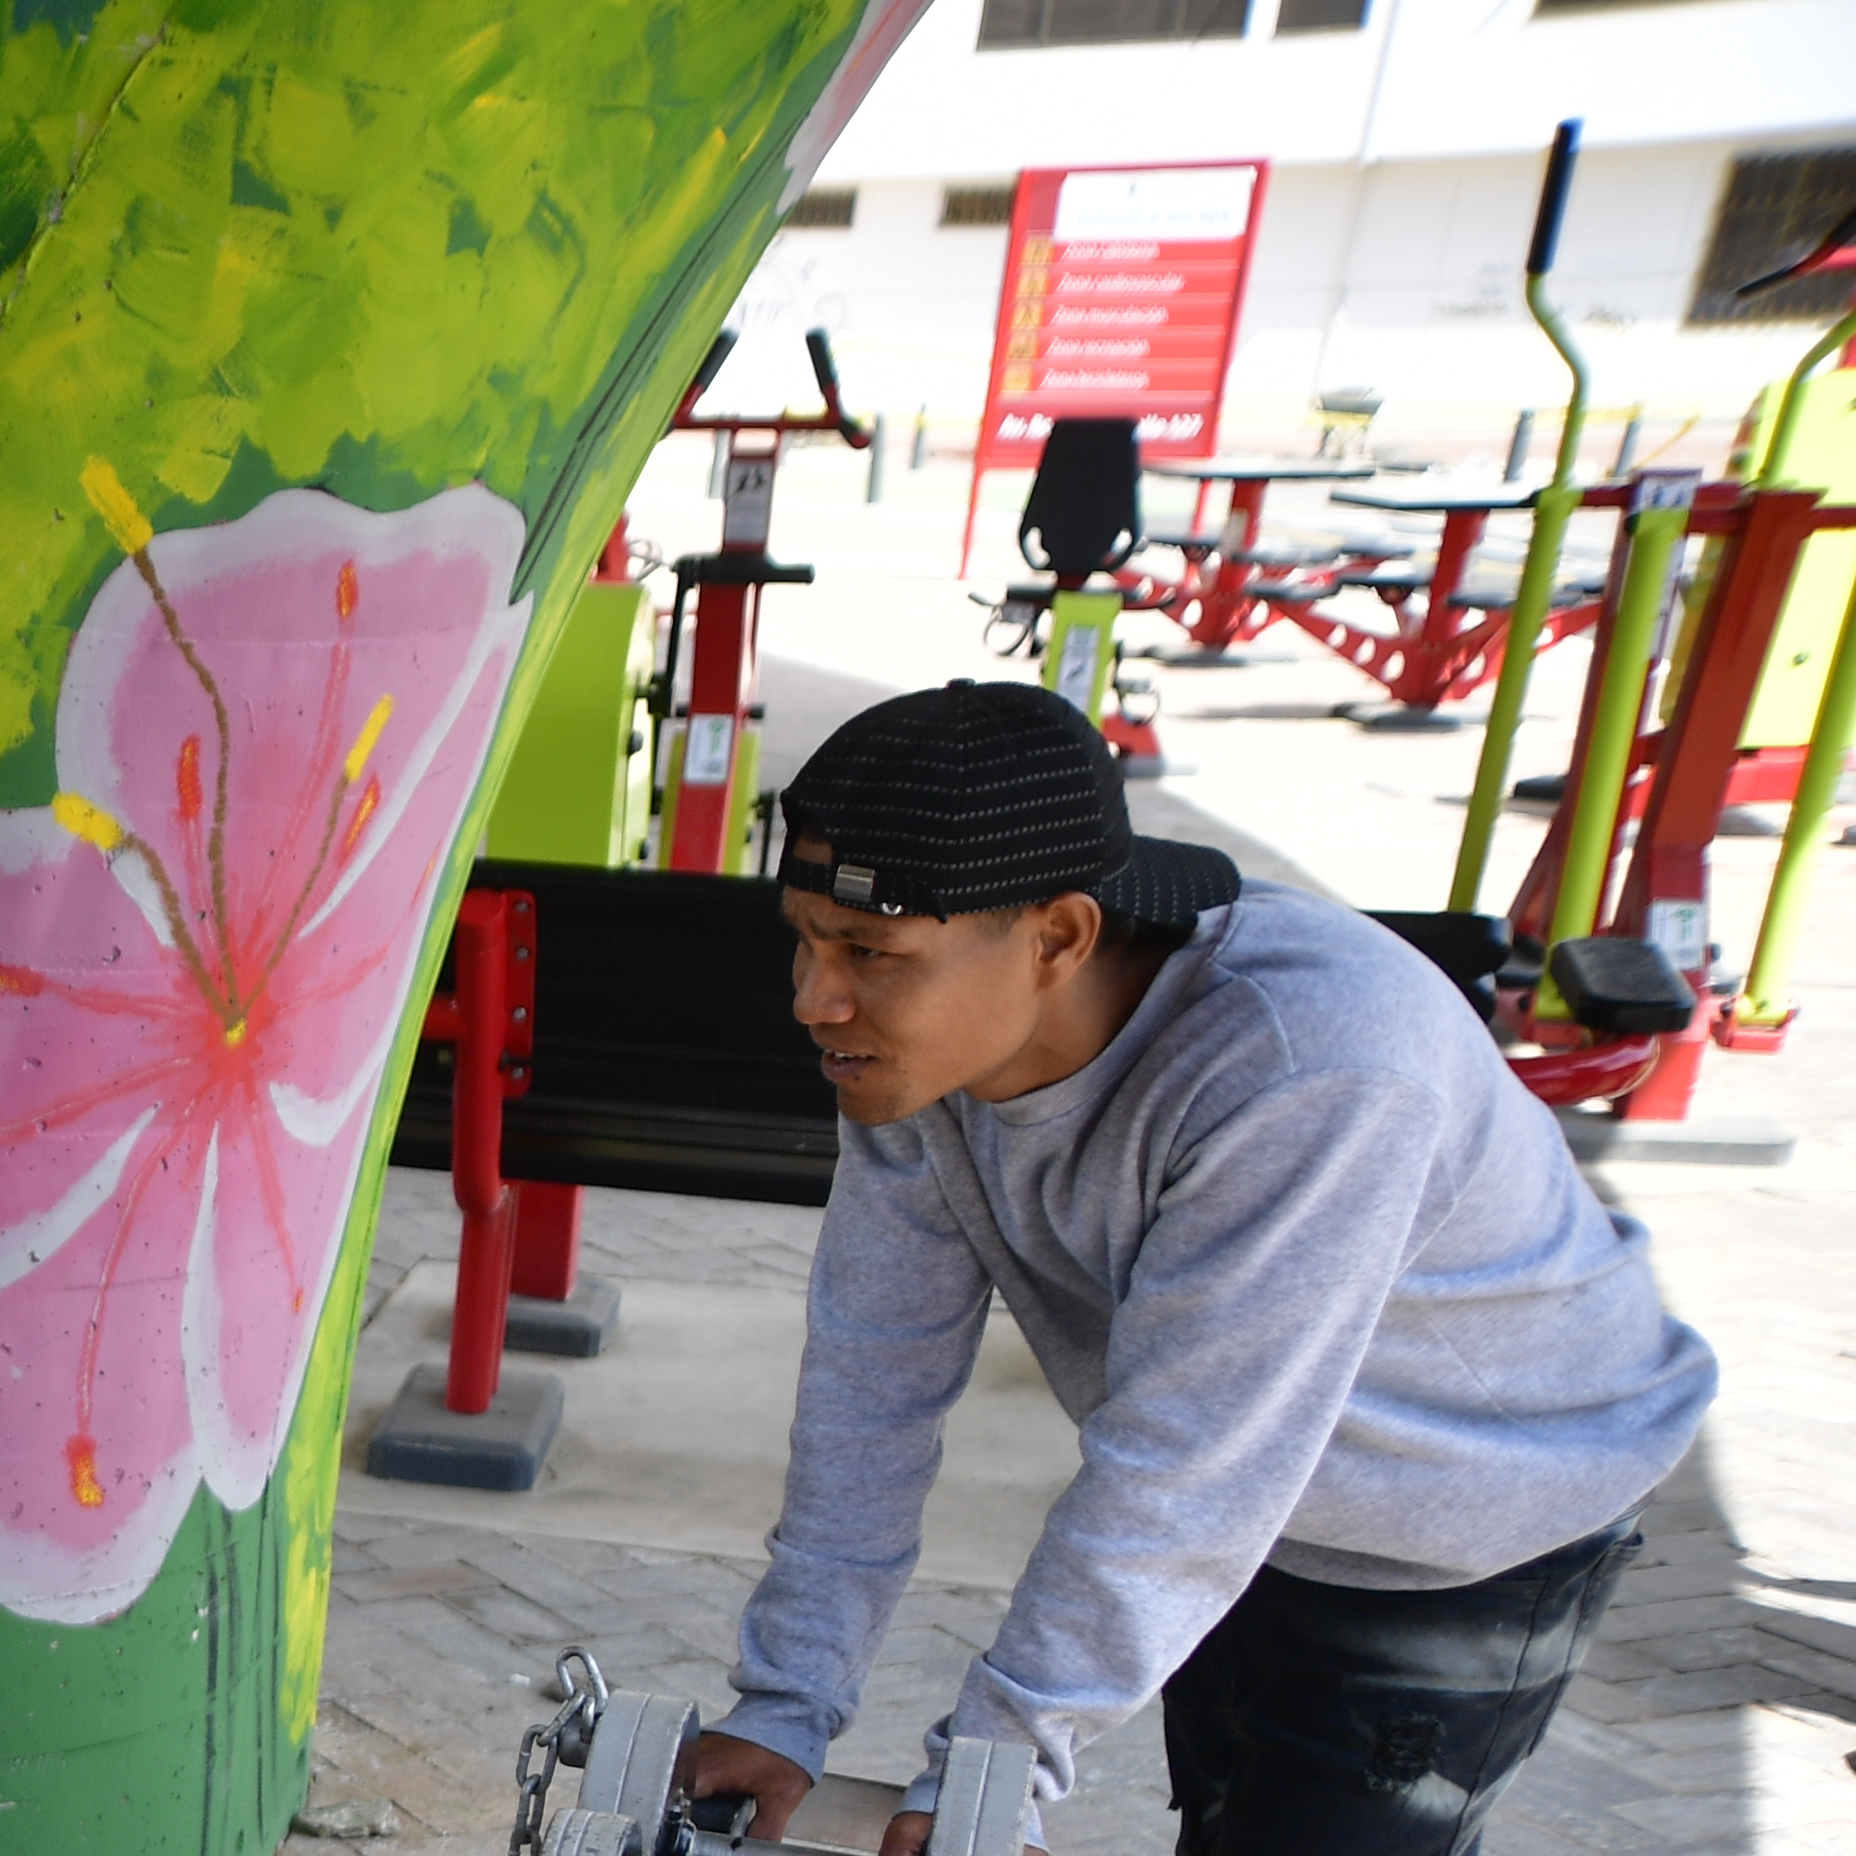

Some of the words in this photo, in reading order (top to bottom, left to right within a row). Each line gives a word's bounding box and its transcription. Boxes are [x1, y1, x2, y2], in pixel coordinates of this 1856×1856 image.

[1055, 271, 1092, 294] Zona
[1092, 271, 1186, 294] cardiovascular
[1050, 303, 1086, 325] Zona
[1044, 336, 1081, 357] Zona
[1039, 368, 1075, 389] Zona
